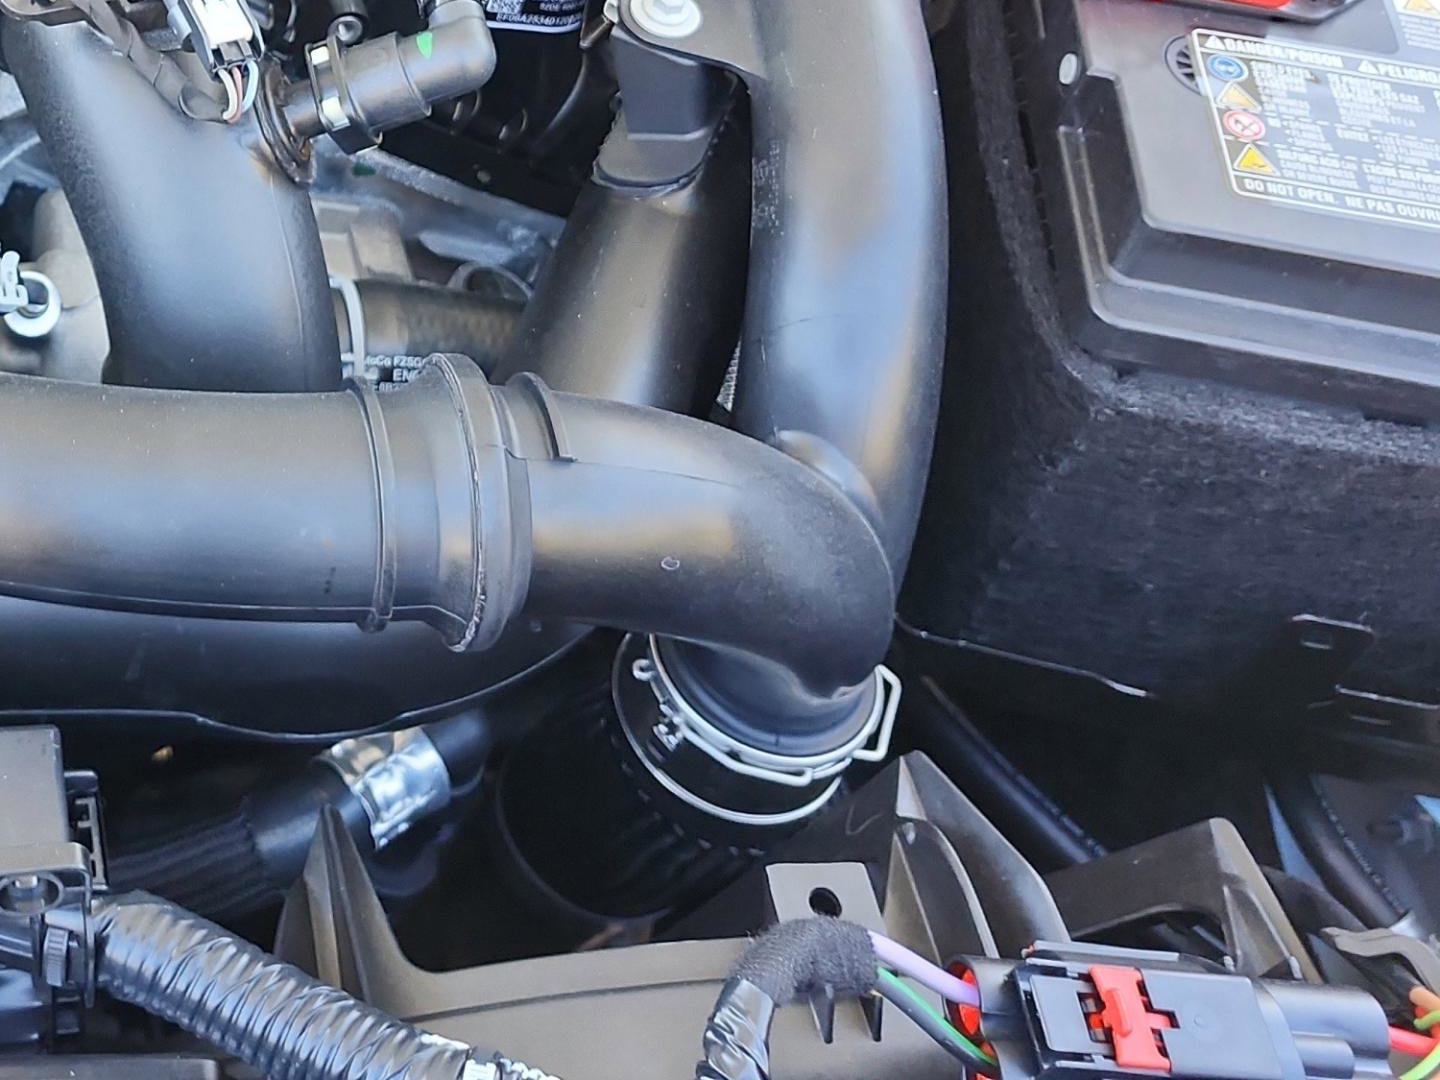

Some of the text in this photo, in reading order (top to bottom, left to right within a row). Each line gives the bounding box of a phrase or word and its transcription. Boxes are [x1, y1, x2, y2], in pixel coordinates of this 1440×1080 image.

[1244, 178, 1265, 192] DO
[1267, 182, 1295, 196] NOT
[1366, 199, 1395, 214] PAS
